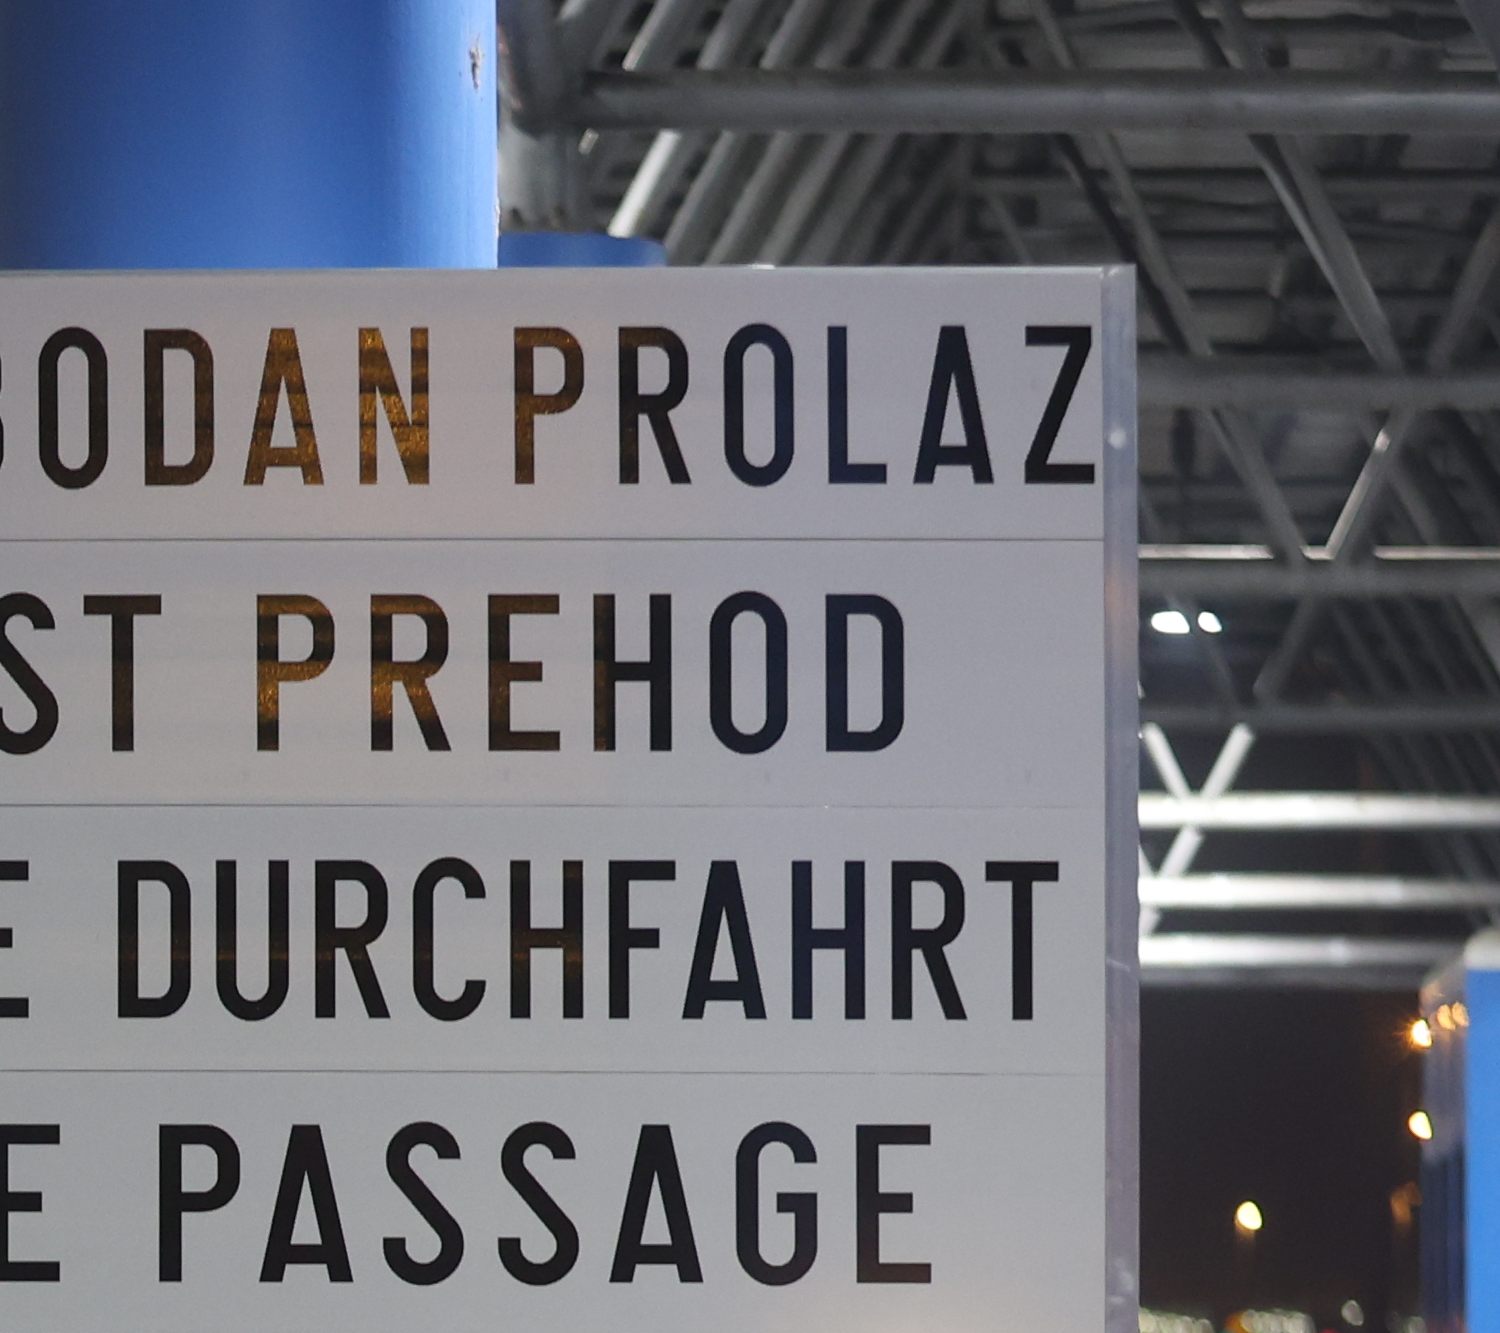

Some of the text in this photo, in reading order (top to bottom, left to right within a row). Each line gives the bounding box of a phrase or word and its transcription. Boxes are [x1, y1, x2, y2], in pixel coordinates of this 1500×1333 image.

[513, 322, 1096, 489] PROLAZ
[256, 590, 905, 755] PREHOD
[117, 856, 1060, 1022] DURCHFAHRT
[158, 1121, 932, 1287] PASSAGE
